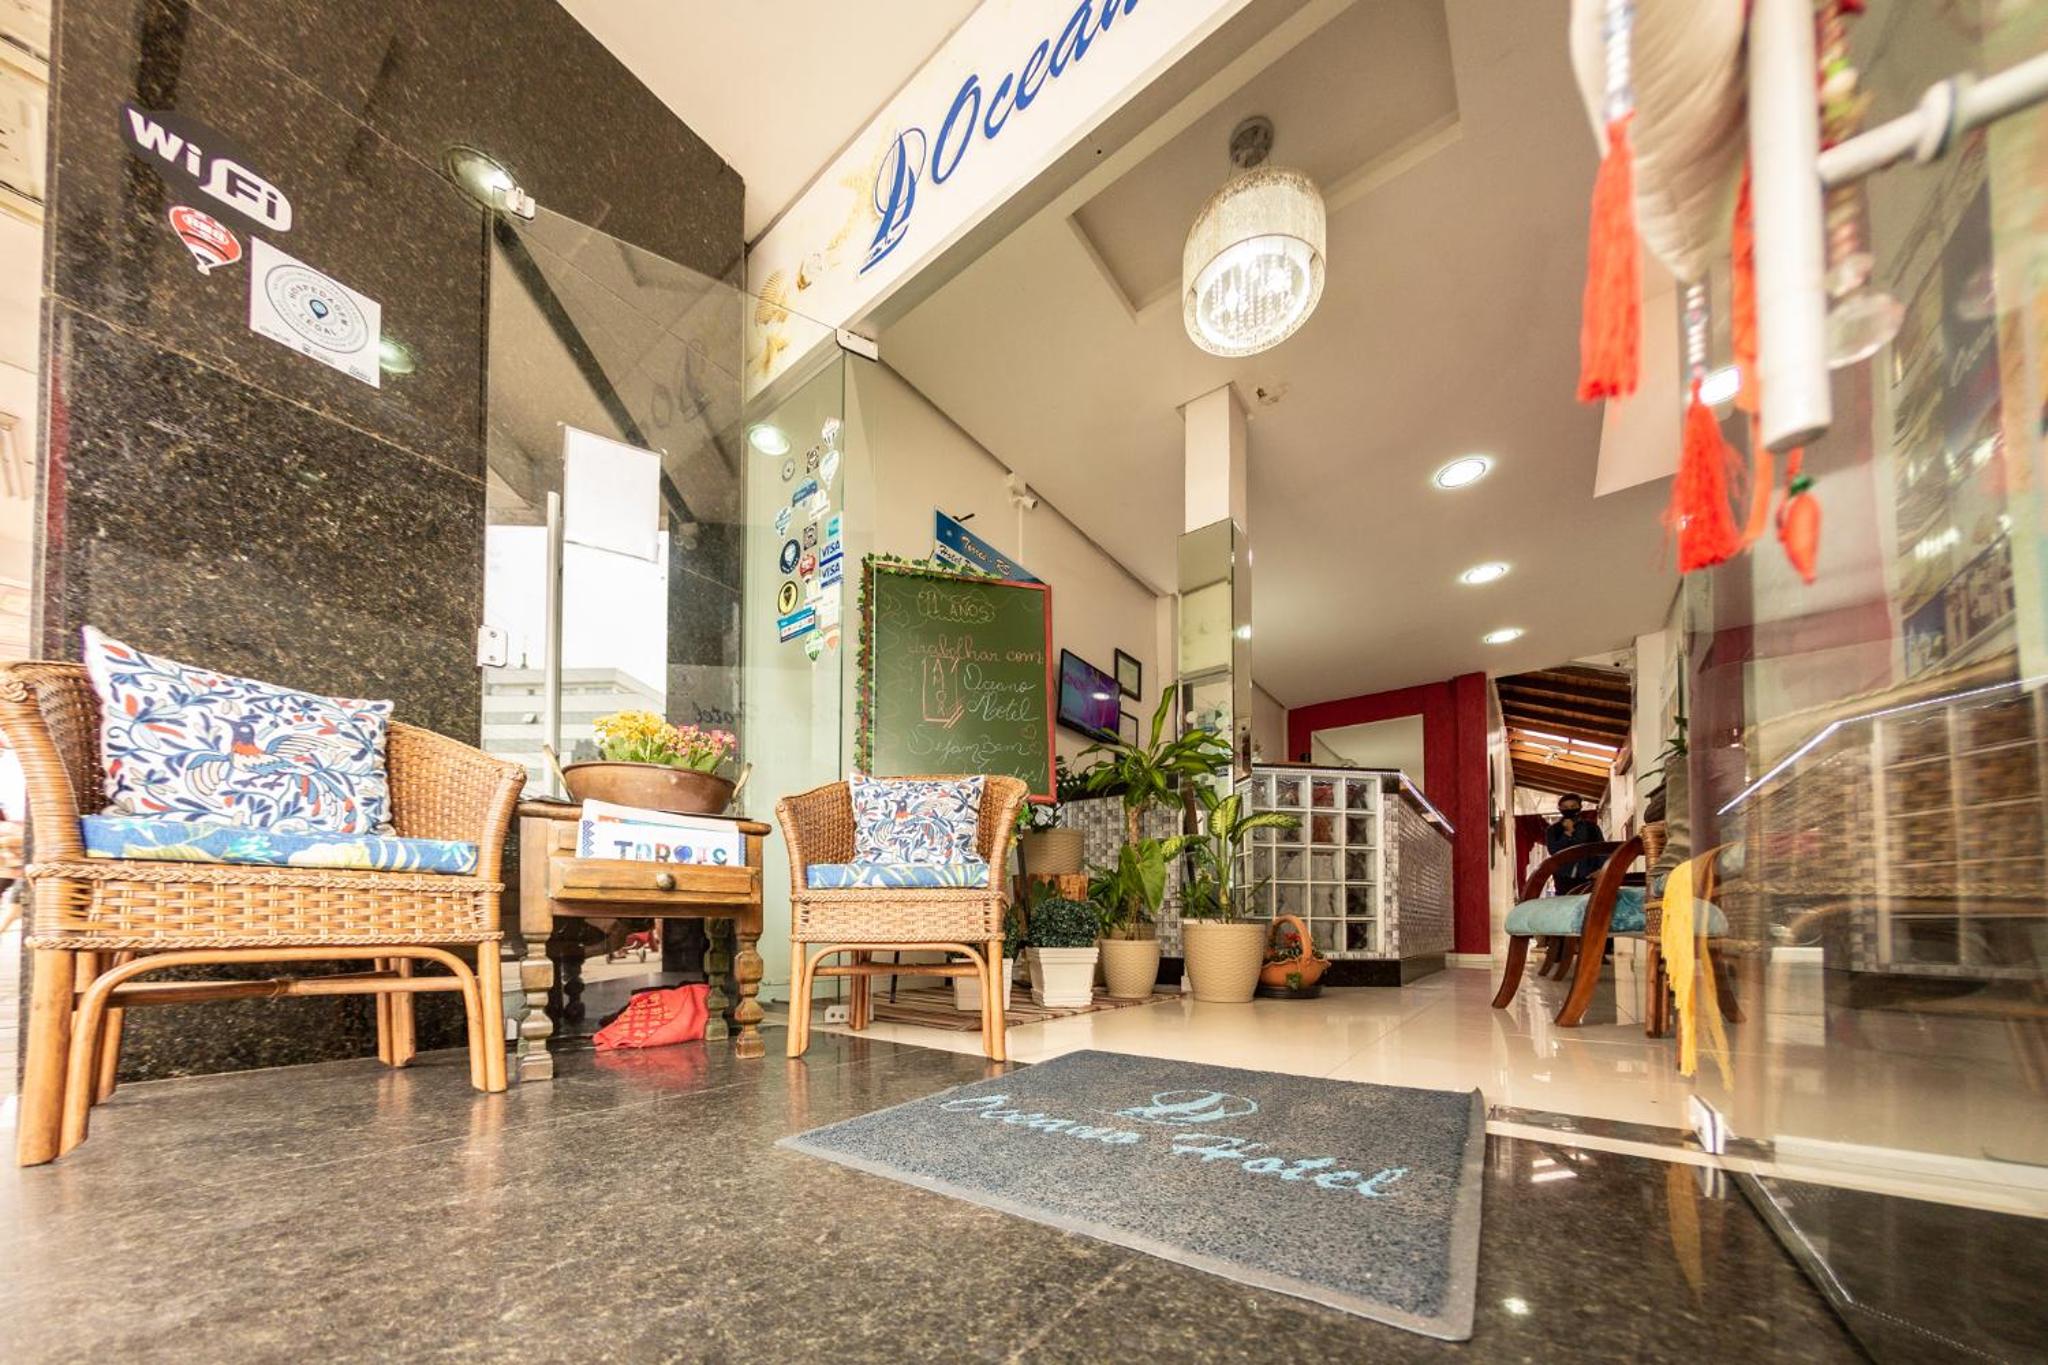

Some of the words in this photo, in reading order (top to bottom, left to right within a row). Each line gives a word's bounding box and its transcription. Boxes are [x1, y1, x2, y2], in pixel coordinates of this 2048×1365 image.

[298, 313, 338, 337] LEGAL
[821, 540, 841, 558] VISA
[821, 562, 841, 579] VISA
[1006, 649, 1044, 665] com
[963, 662, 1037, 693] Oceano
[939, 1094, 1143, 1145] Oceano
[1171, 1132, 1409, 1198] Hotel
